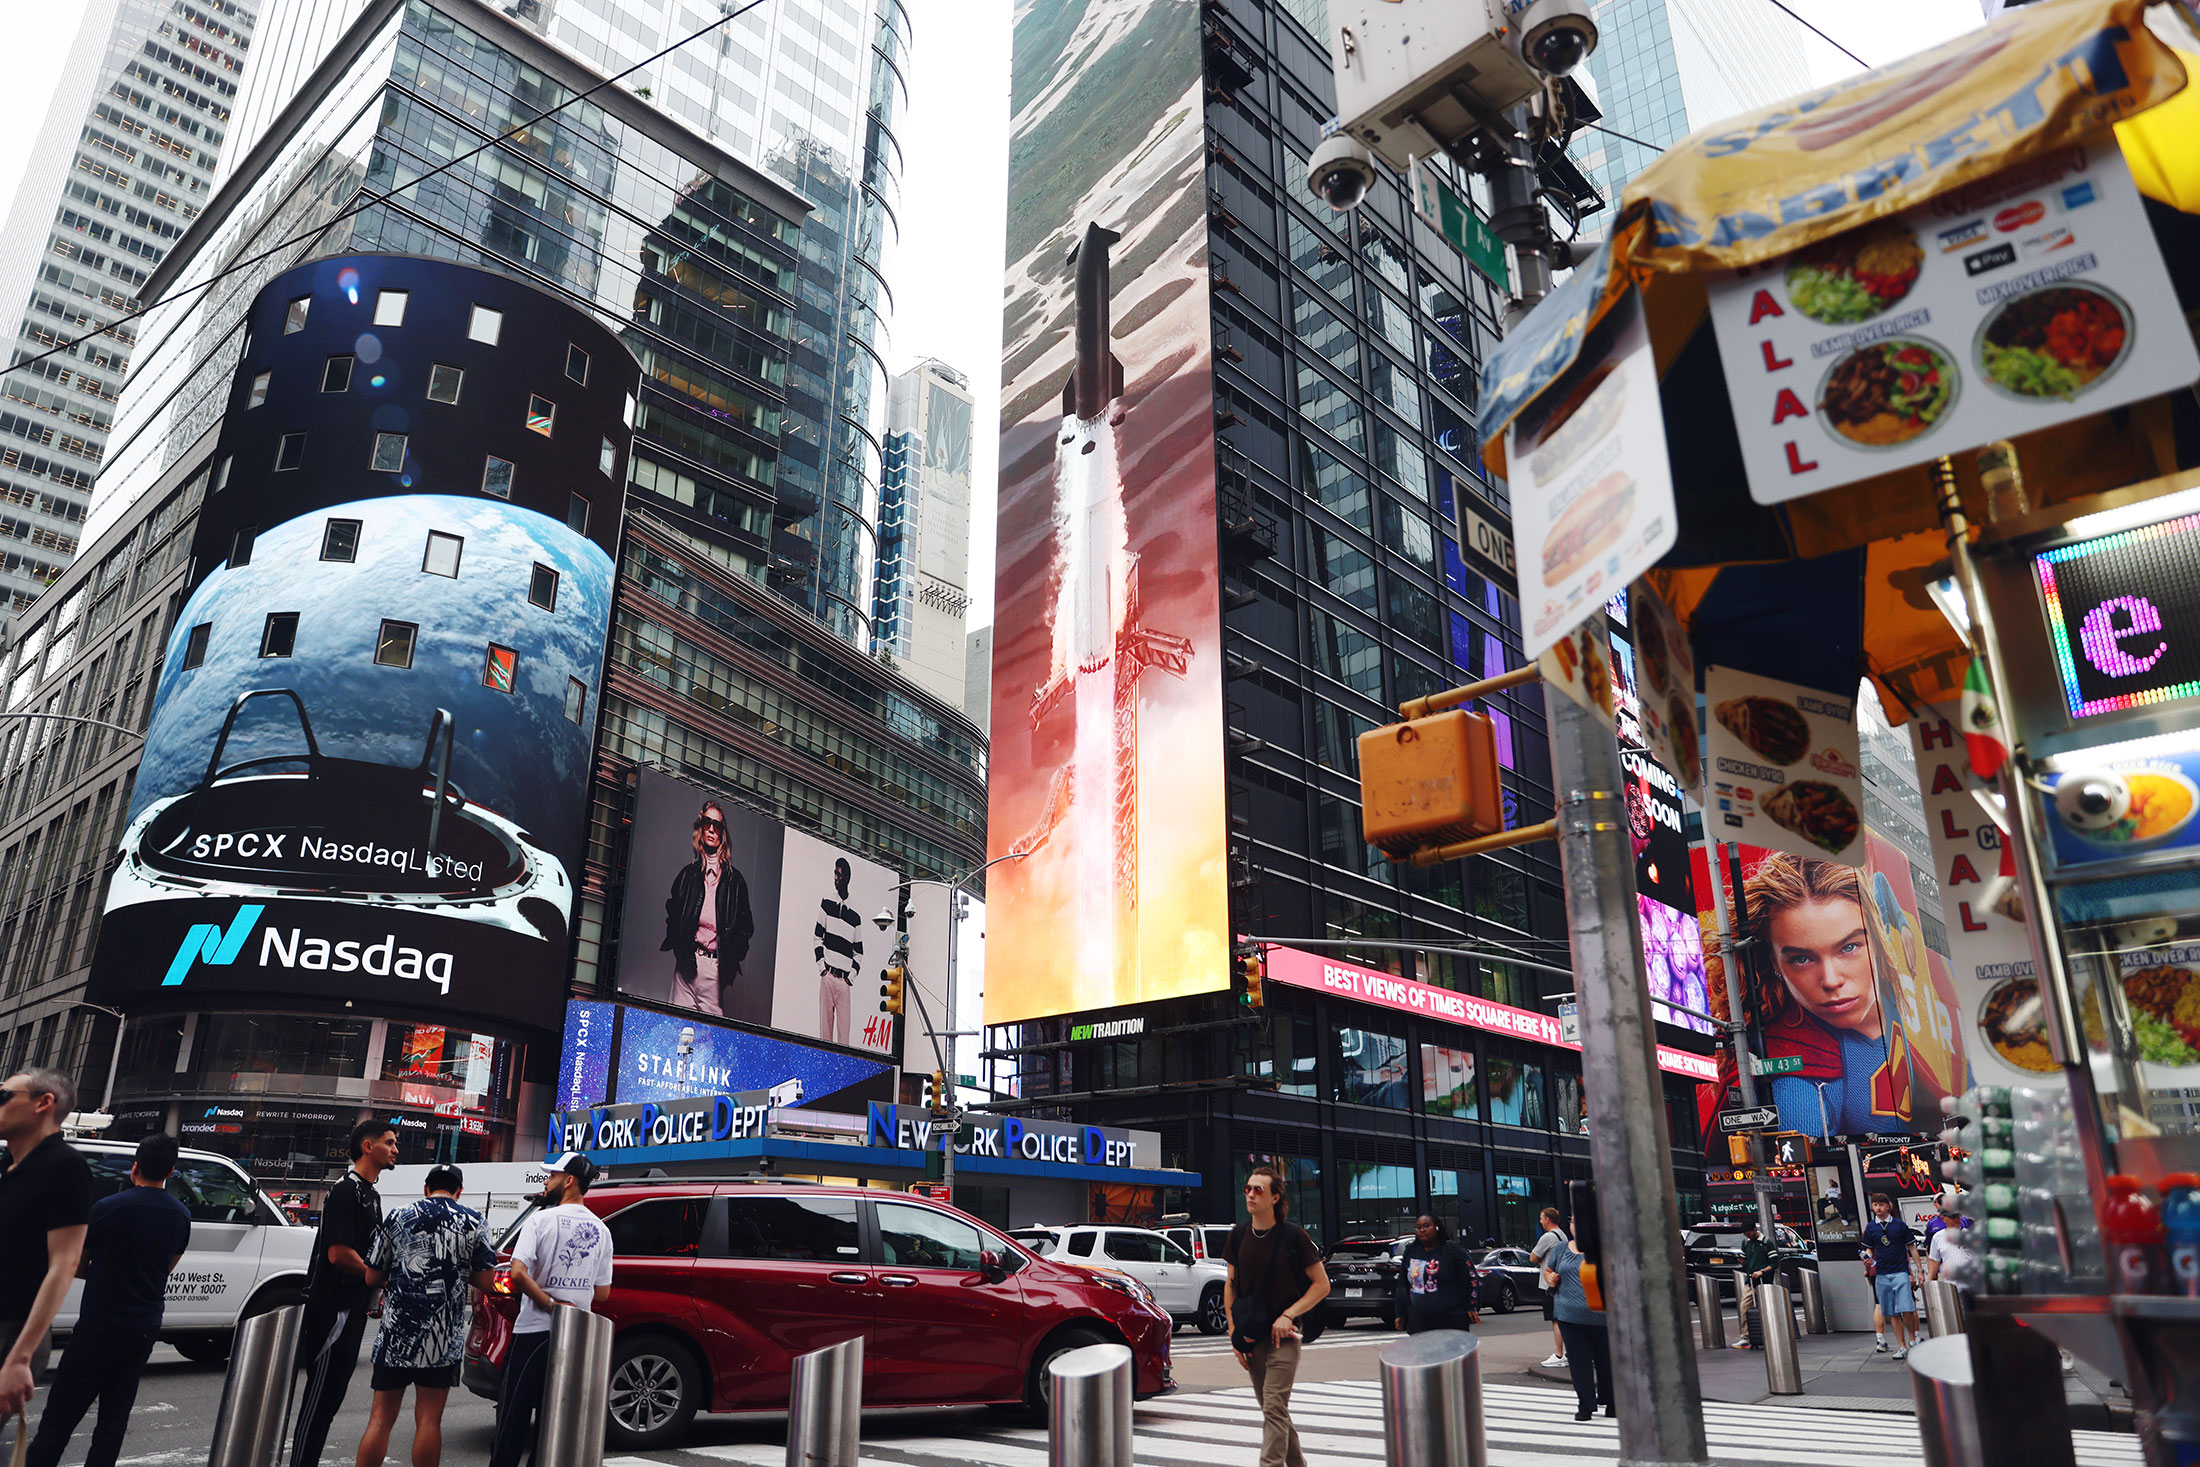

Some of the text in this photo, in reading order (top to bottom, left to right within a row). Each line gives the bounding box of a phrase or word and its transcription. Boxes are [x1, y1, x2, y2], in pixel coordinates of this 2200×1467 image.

[1455, 204, 1467, 248] 7
[1975, 251, 2099, 306] MIX OVER RICE
[1854, 320, 1895, 346] OVER
[1893, 307, 1932, 336] RICE
[1477, 521, 1517, 574] ONE
[2079, 593, 2168, 679] e
[1621, 753, 1678, 797] COMING
[1717, 756, 1785, 785] CHICKEN GYRO
[1642, 793, 1683, 834] SOON
[1918, 718, 1989, 934] HALAL
[193, 833, 287, 859] SPCX
[258, 926, 454, 996] Nasdaq
[1975, 960, 2036, 981] LAMB OVE
[1323, 964, 1540, 1034] BEST VIEWS OF TIMES SQUARE HERE
[576, 1009, 590, 1048] SPCX
[862, 1015, 893, 1051] H&M
[638, 1053, 732, 1088] STARLINK
[638, 1077, 655, 1087] FAST
[1657, 1050, 1718, 1079] QUARE SKYWALK
[1763, 1057, 1801, 1073] W 43 St
[216, 1108, 336, 1121] Nasdaq REWRITE TOMORROW
[401, 1118, 427, 1130] Nasdaq
[547, 1095, 768, 1153] NEW YORK POLICE DEPT
[1724, 1112, 1770, 1125] ONE WAY
[867, 1101, 933, 1151] NEW
[1003, 1117, 1078, 1164] POLICE
[1083, 1126, 1138, 1168] DEPT
[254, 1157, 294, 1170] Nasdaq
[169, 1272, 225, 1283] 140 West St.
[2119, 1248, 2148, 1279] G
[2171, 1247, 2198, 1279] G
[182, 1284, 198, 1294] NY
[200, 1284, 227, 1294] 10007
